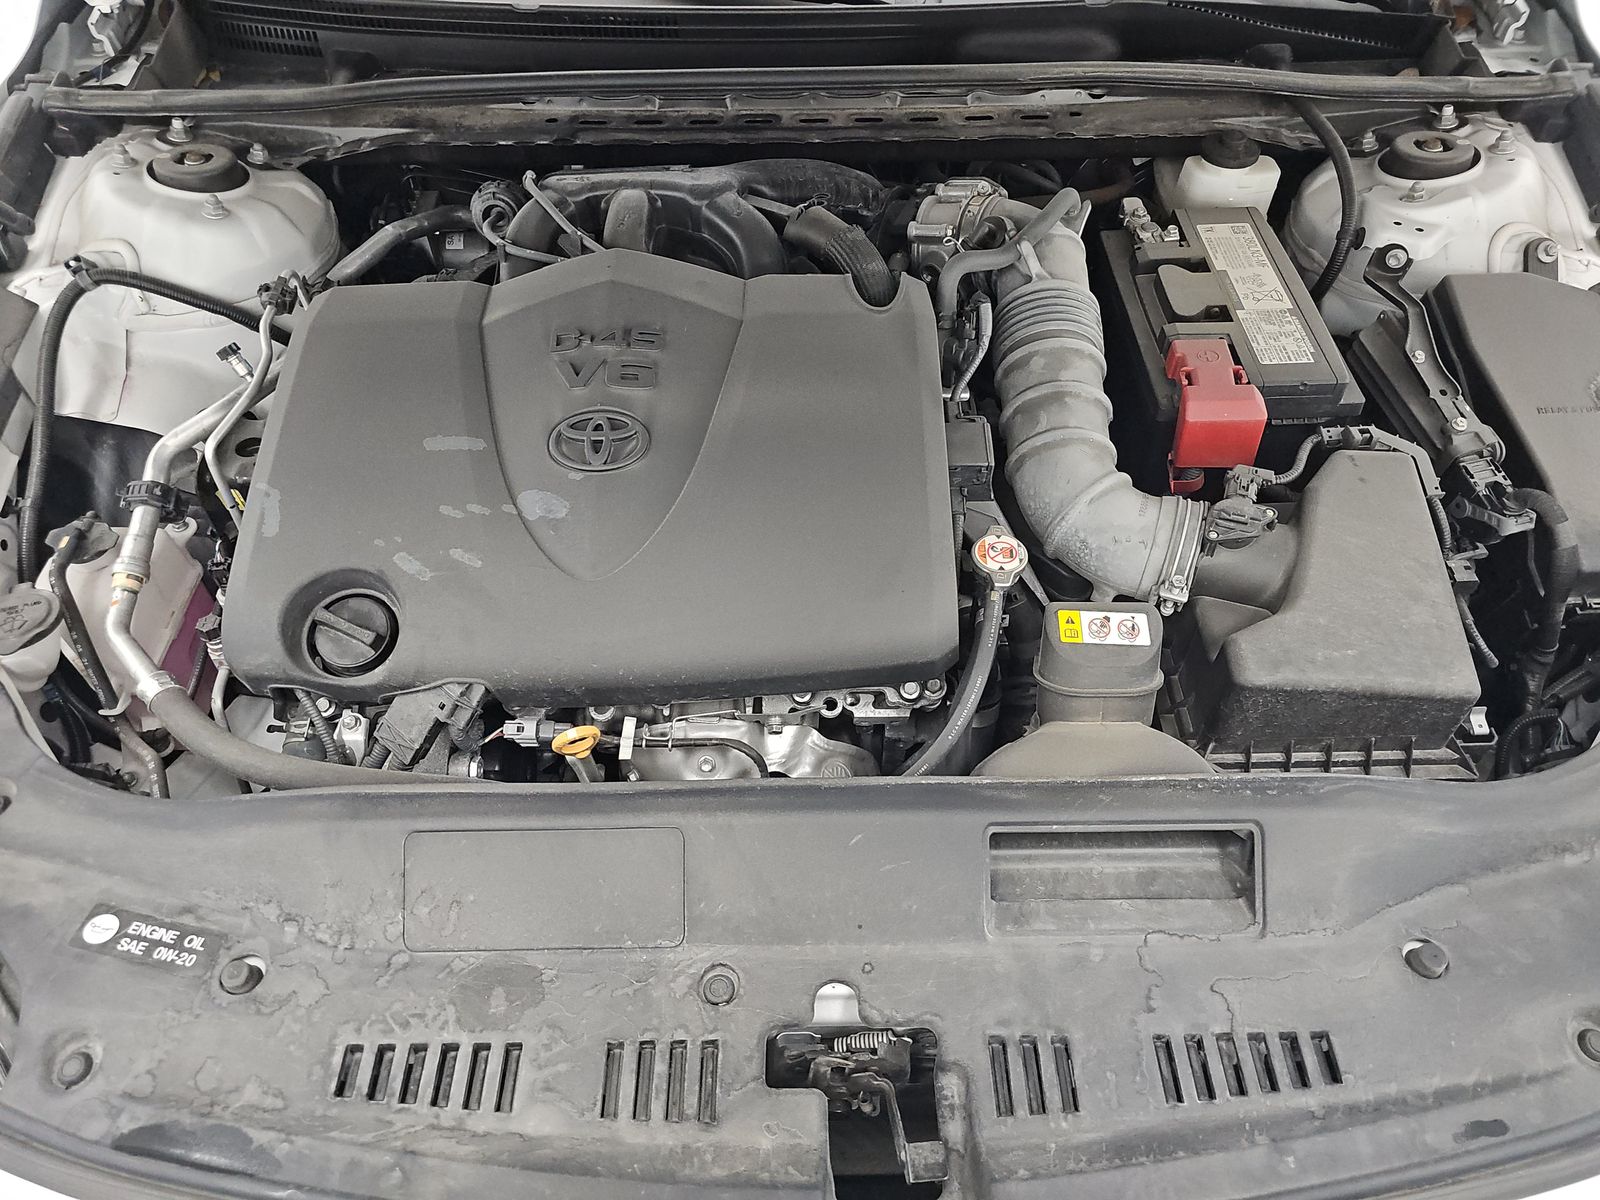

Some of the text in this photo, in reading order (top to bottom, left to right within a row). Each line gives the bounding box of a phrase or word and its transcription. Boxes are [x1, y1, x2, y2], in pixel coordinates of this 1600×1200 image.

[555, 358, 656, 390] V6
[1536, 406, 1568, 415] RELAY
[956, 708, 968, 725] WATER
[127, 921, 180, 944] ENGINE
[183, 935, 205, 951] OIL
[116, 937, 197, 967] SAE 0W-20
